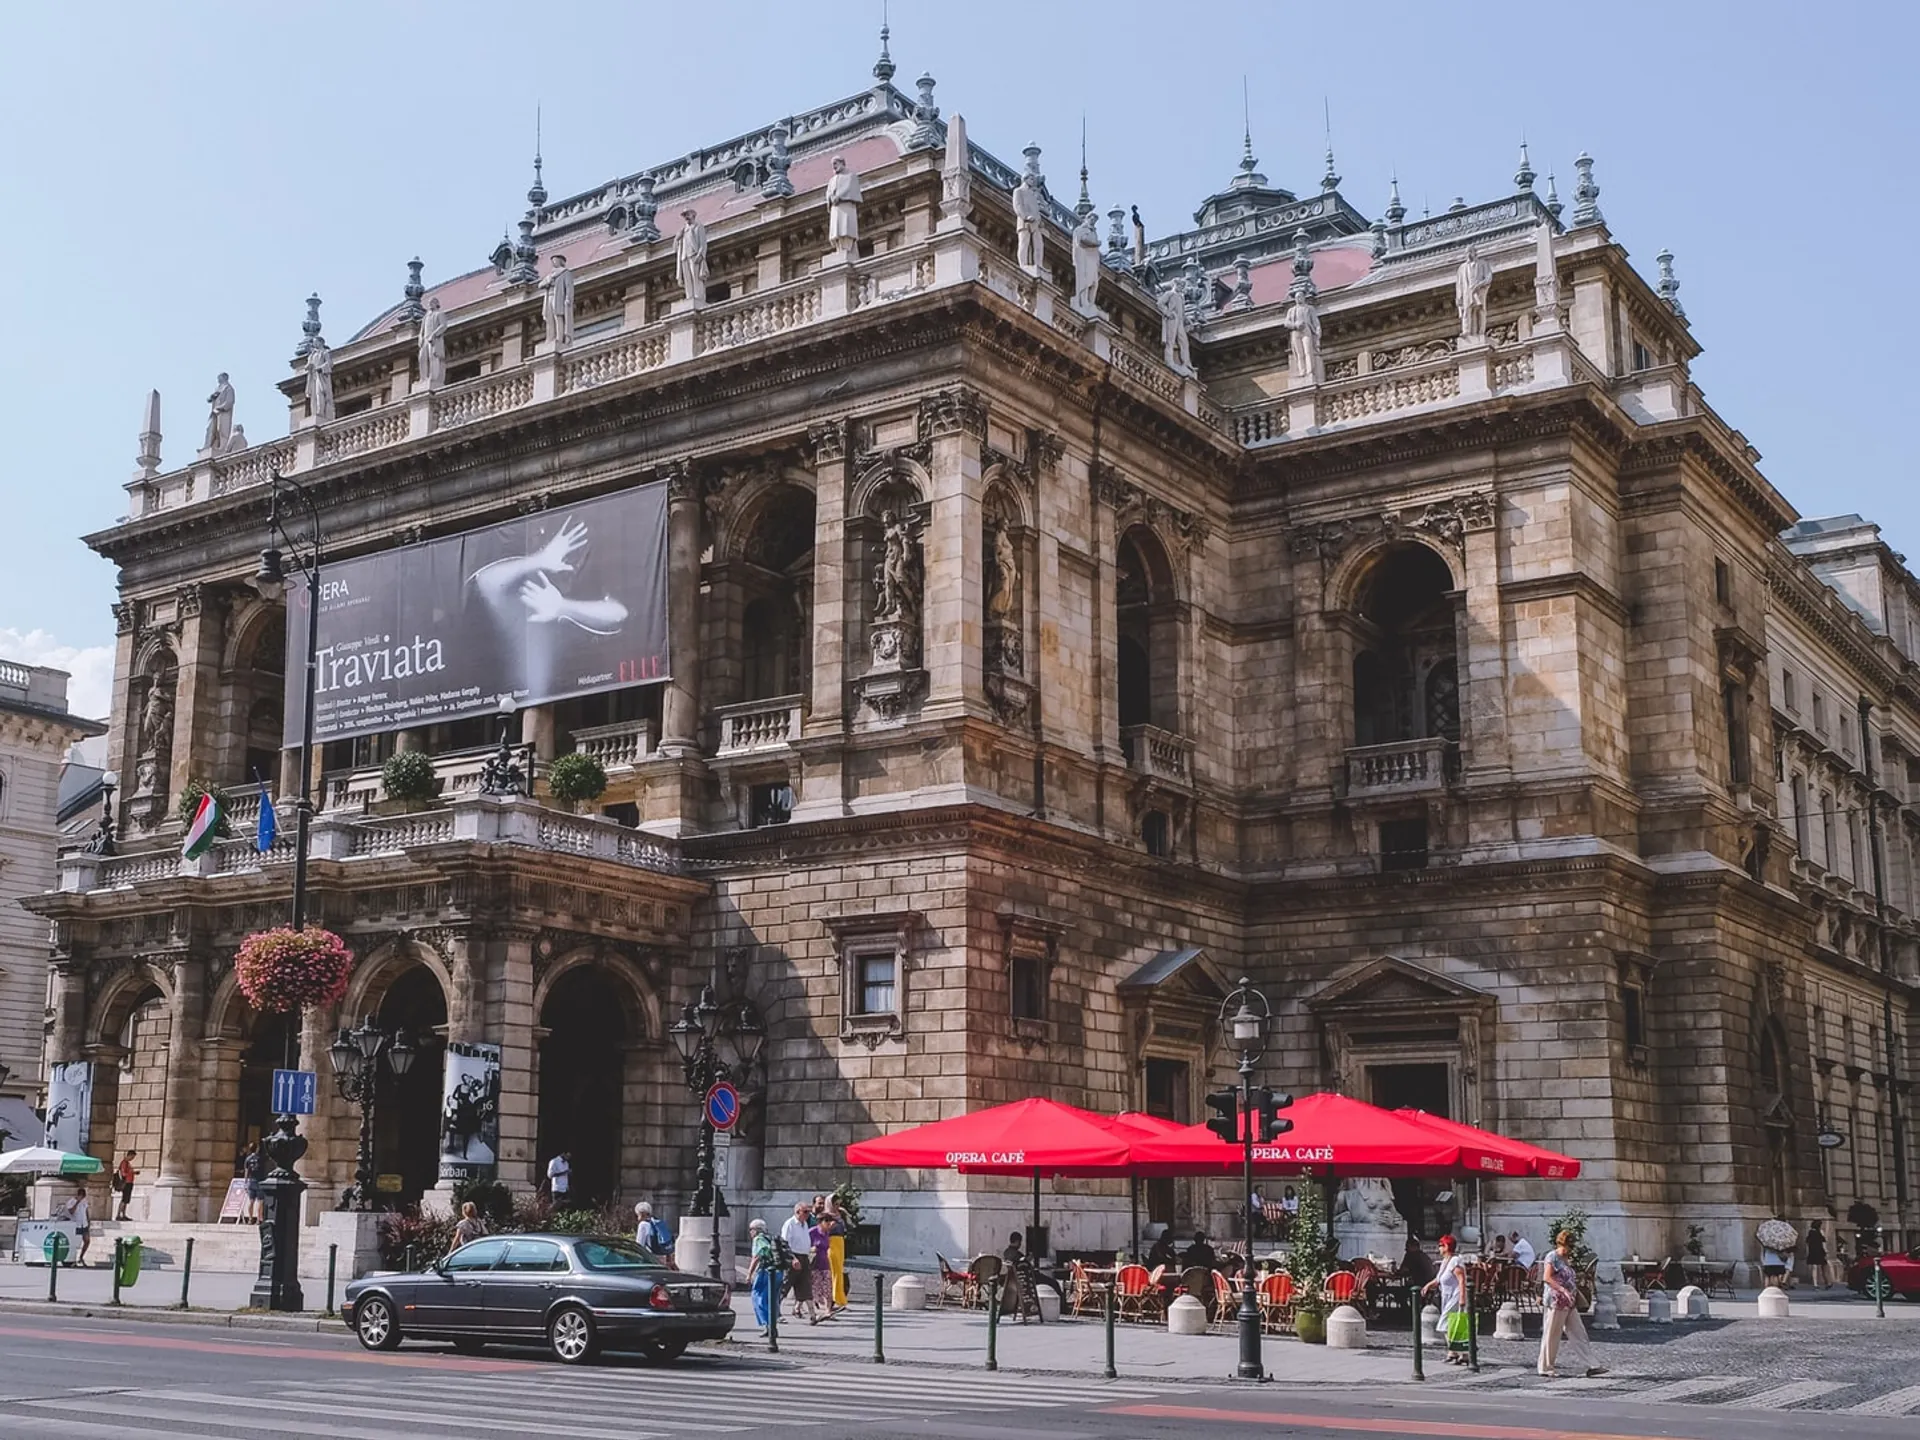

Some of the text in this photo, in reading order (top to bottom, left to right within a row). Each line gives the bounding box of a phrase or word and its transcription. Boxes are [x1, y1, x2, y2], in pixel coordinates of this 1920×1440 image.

[315, 634, 446, 694] Traviata
[945, 1152, 987, 1163] OPERA
[1251, 1148, 1291, 1159] PERA
